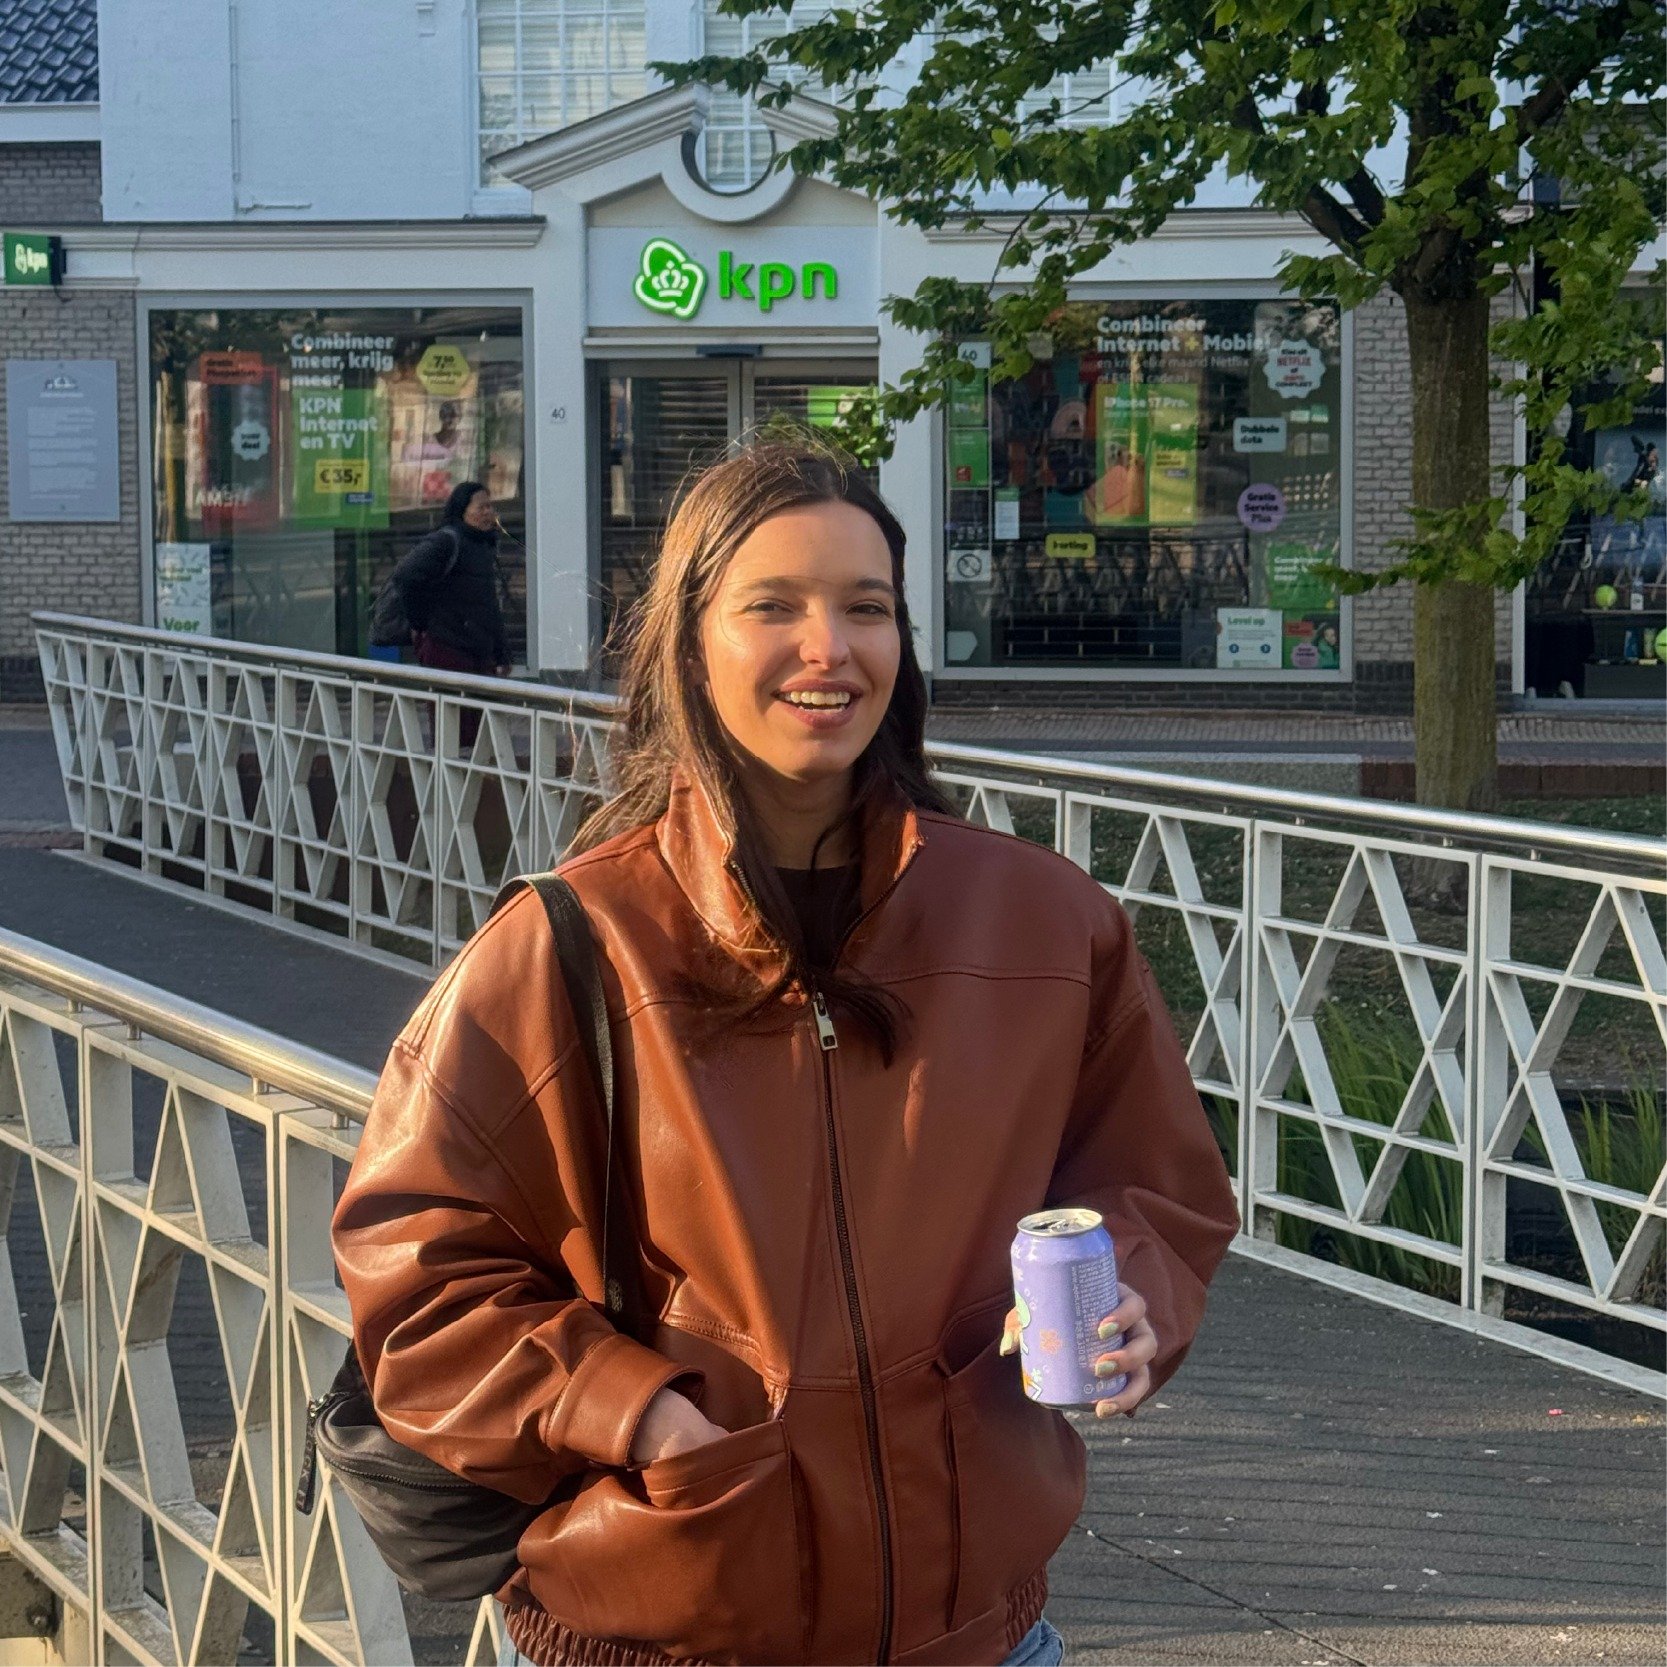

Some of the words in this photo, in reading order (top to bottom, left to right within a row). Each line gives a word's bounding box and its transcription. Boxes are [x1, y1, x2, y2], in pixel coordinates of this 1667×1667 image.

[718, 250, 838, 312] kpn
[1096, 314, 1206, 333] Combineer
[291, 332, 394, 350] Combineer
[1096, 336, 1181, 353] Internet
[291, 355, 345, 371] meer,
[348, 351, 394, 372] krijg
[300, 397, 342, 414] KPN
[551, 407, 566, 419] 40
[300, 416, 378, 432] Internet
[300, 436, 324, 449] en
[327, 433, 355, 449] TV
[1244, 503, 1279, 513] Service
